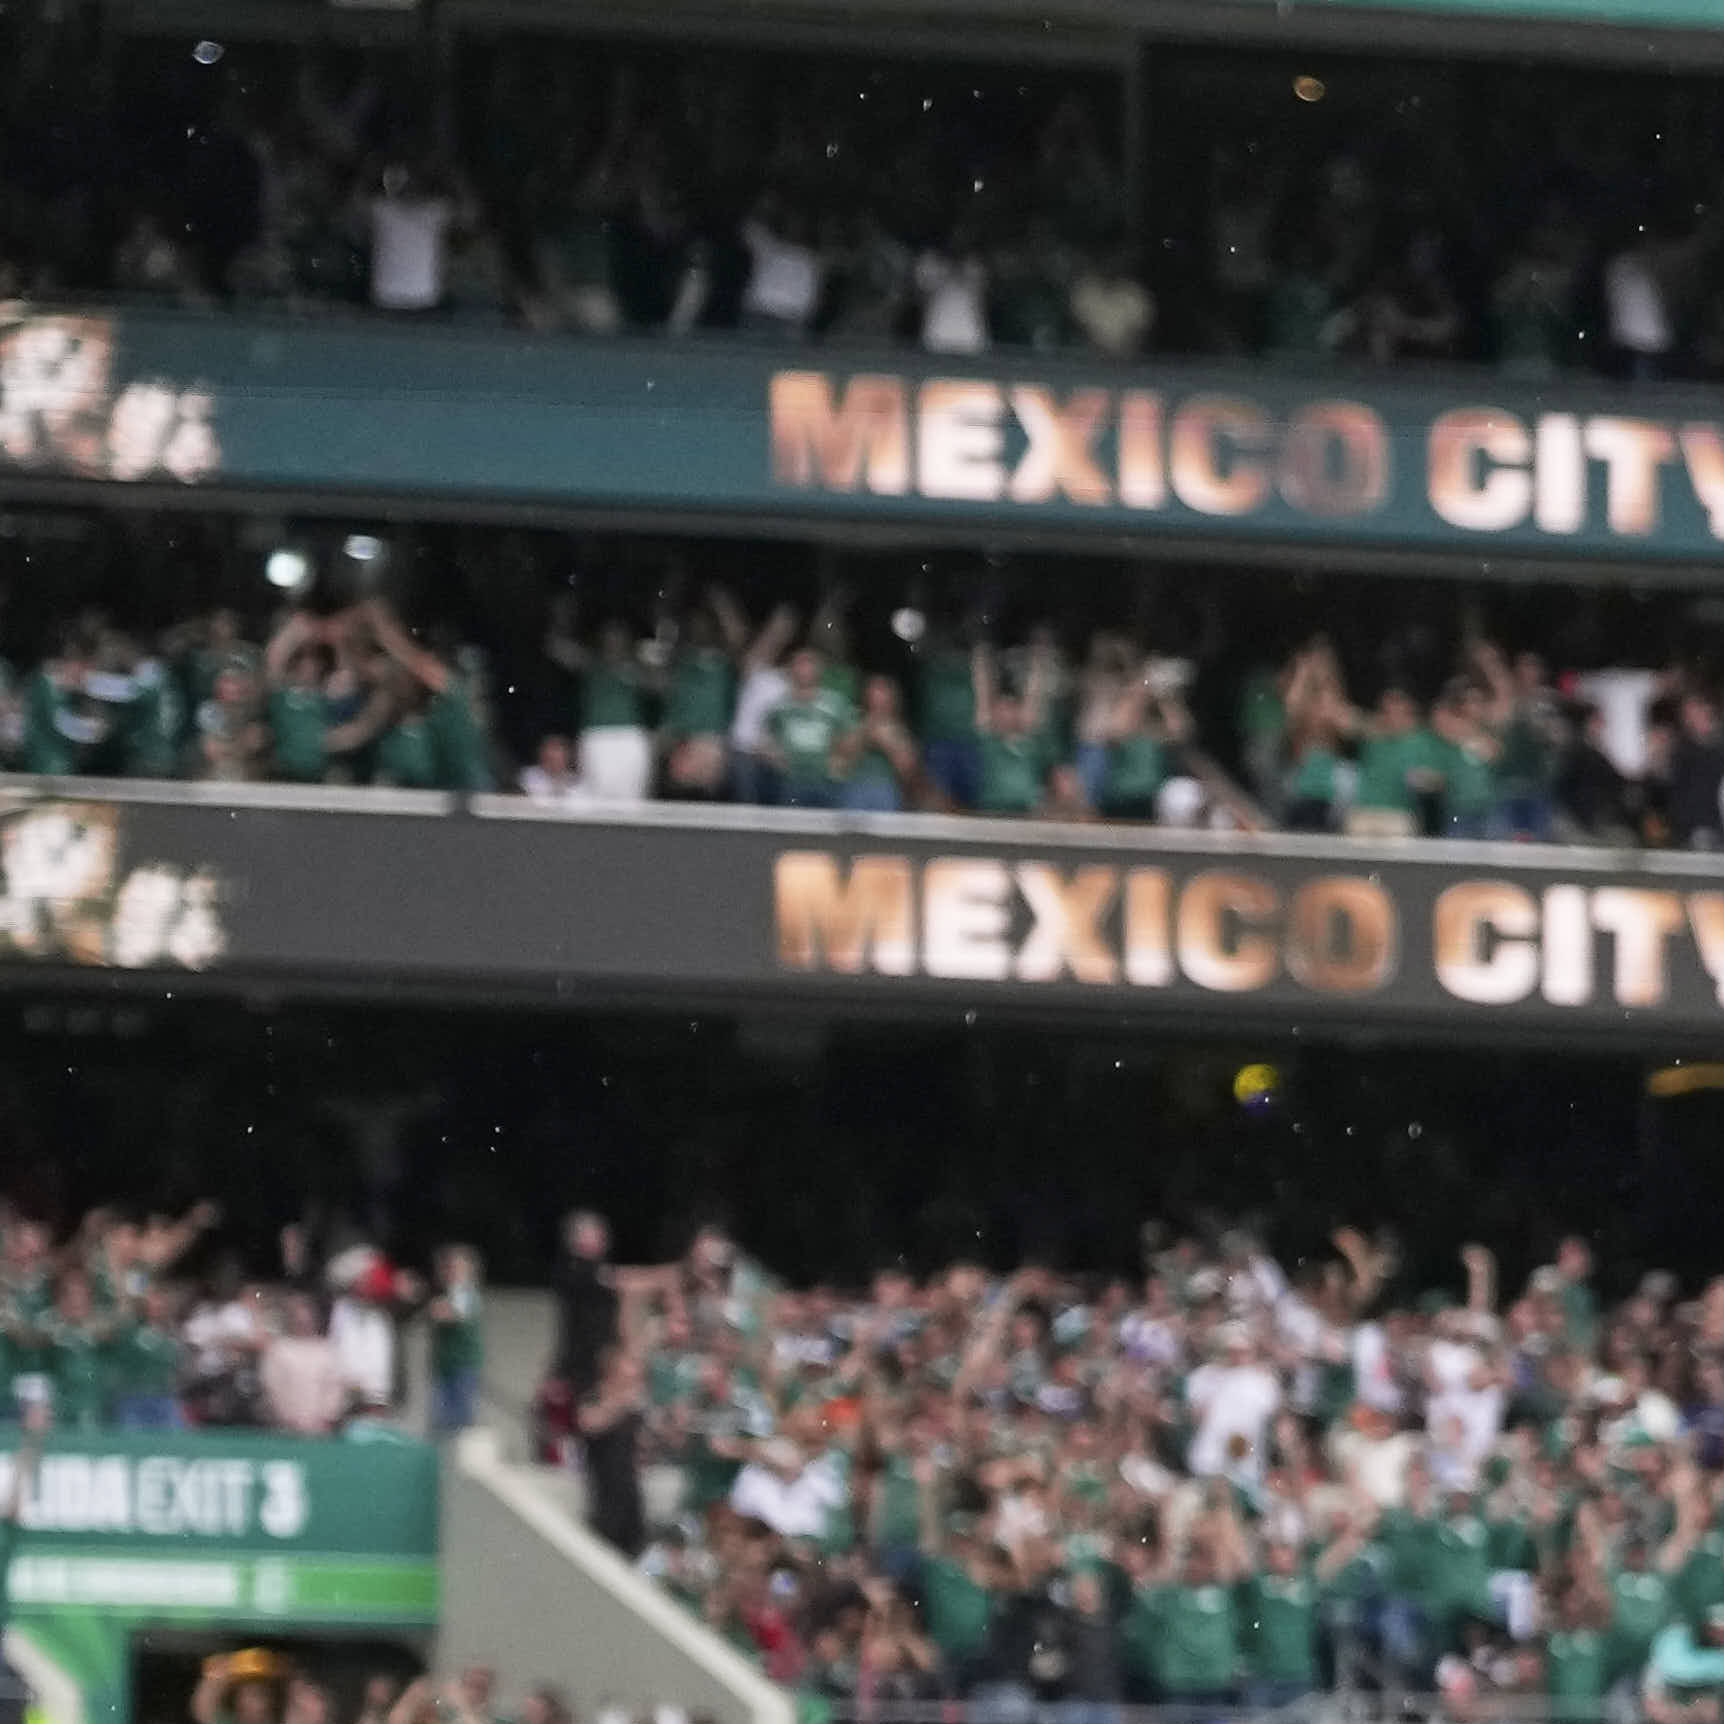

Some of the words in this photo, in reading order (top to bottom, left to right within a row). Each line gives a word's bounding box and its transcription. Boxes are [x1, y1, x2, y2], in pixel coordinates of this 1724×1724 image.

[769, 371, 1387, 517] MEXICO
[772, 850, 1393, 994] MEXICO
[6, 1452, 134, 1533] LIDA
[136, 1456, 253, 1537] EXIT
[260, 1459, 308, 1539] 3
